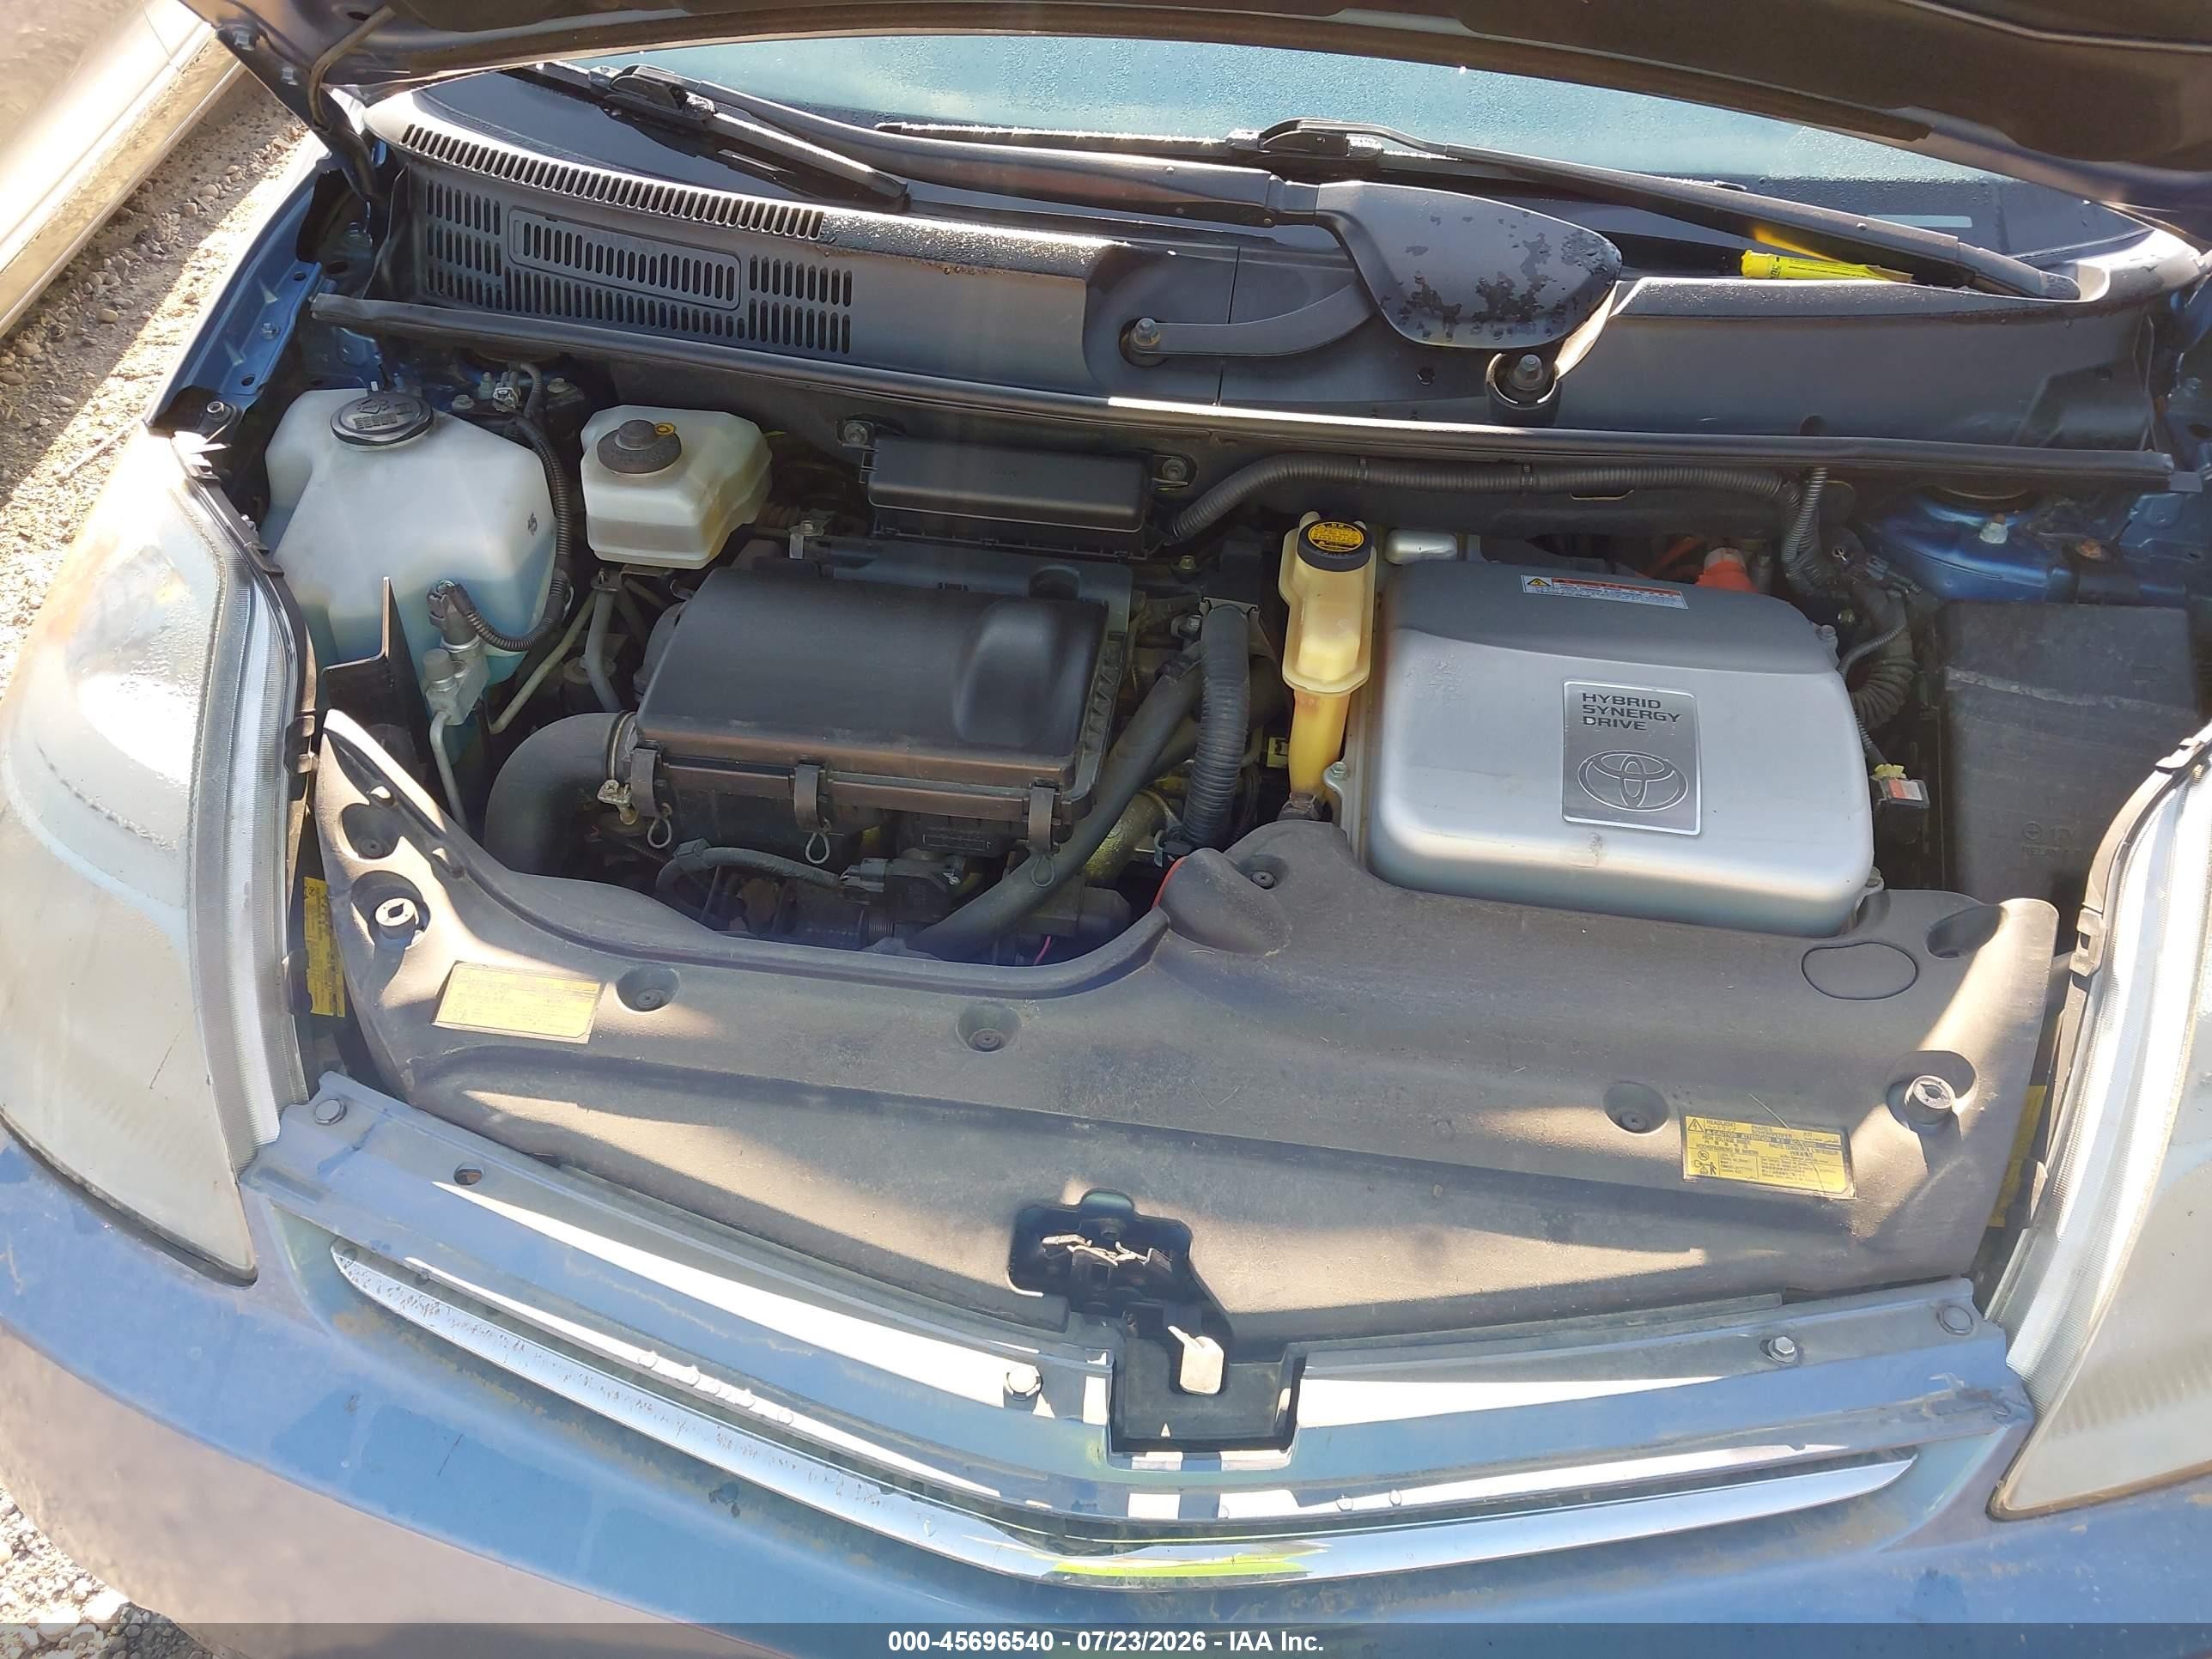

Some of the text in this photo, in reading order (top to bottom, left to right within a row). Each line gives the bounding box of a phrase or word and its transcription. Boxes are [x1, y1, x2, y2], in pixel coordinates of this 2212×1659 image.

[1583, 693, 1662, 709] HYBRID
[1583, 704, 1682, 723] SYNERGY
[1583, 715, 1647, 731] DRIVE
